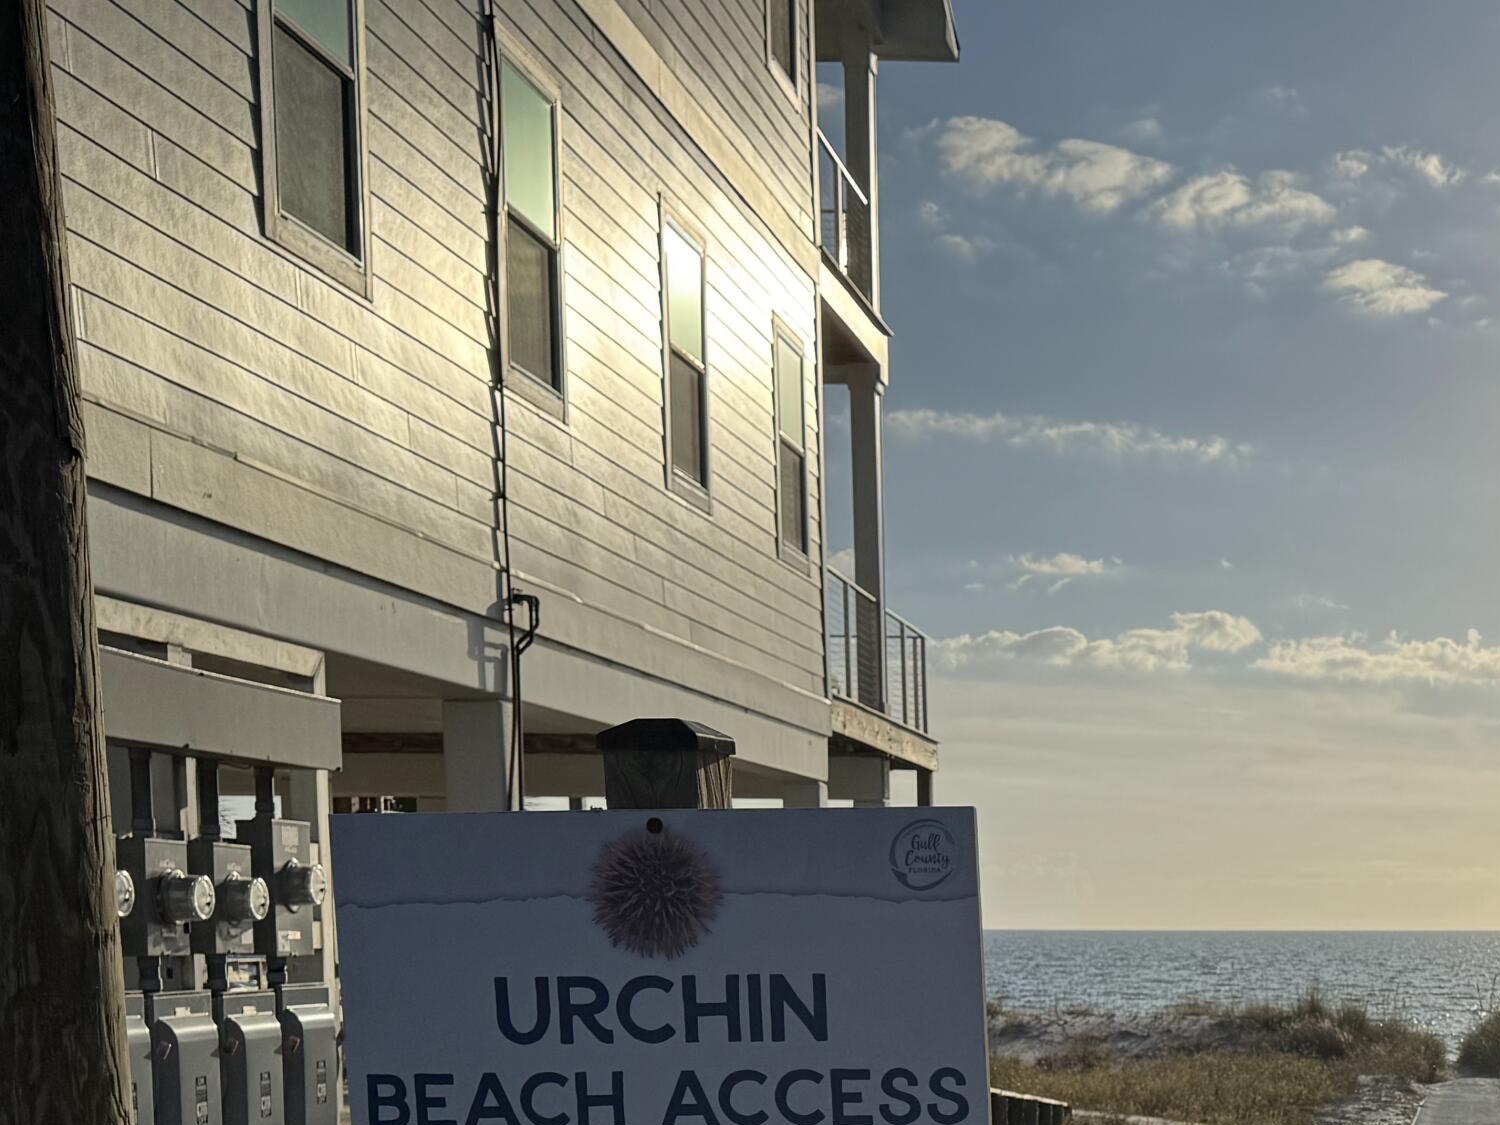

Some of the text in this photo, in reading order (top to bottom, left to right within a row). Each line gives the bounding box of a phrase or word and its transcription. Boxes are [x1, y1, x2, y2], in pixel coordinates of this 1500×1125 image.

[911, 833, 941, 851] Gulf
[905, 850, 949, 870] County
[493, 972, 829, 1046] URCHIN
